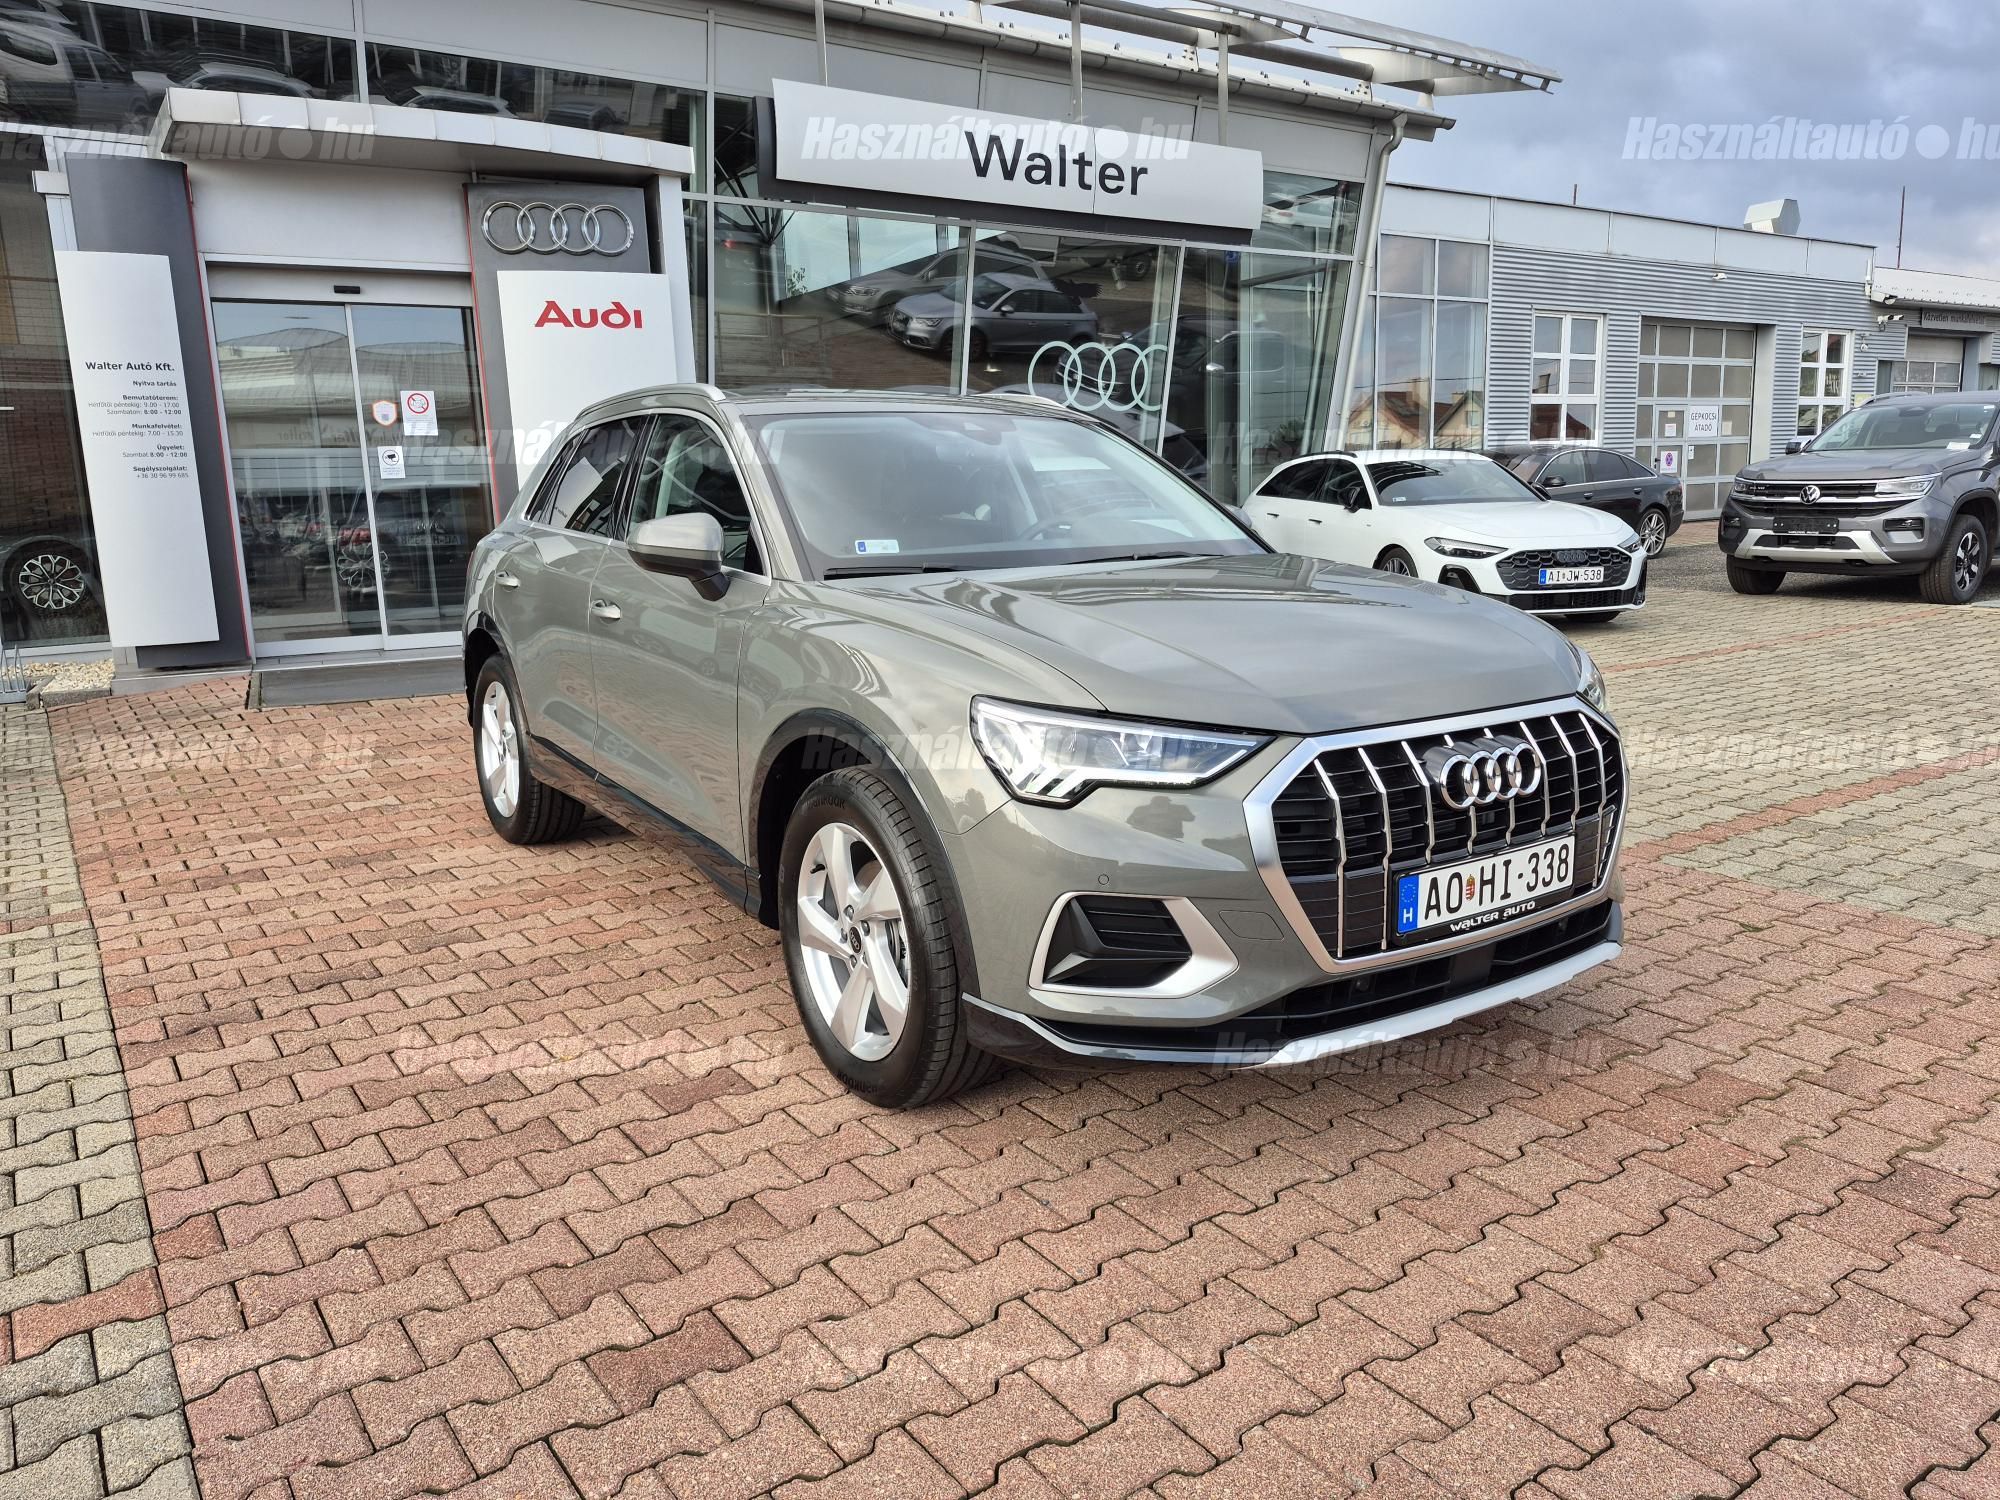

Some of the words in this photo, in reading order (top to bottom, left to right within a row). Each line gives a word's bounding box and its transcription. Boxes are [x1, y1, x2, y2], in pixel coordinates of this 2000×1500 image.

[964, 130, 1149, 196] Walter
[534, 300, 643, 329] Audi
[85, 361, 123, 370] Walter
[126, 361, 152, 371] Autó
[155, 363, 175, 371] Kft.
[1548, 571, 1560, 582] AI
[1567, 569, 1602, 582] JW-538
[1402, 906, 1414, 924] H
[1424, 871, 1463, 920] AO
[1479, 843, 1570, 907] HI-338
